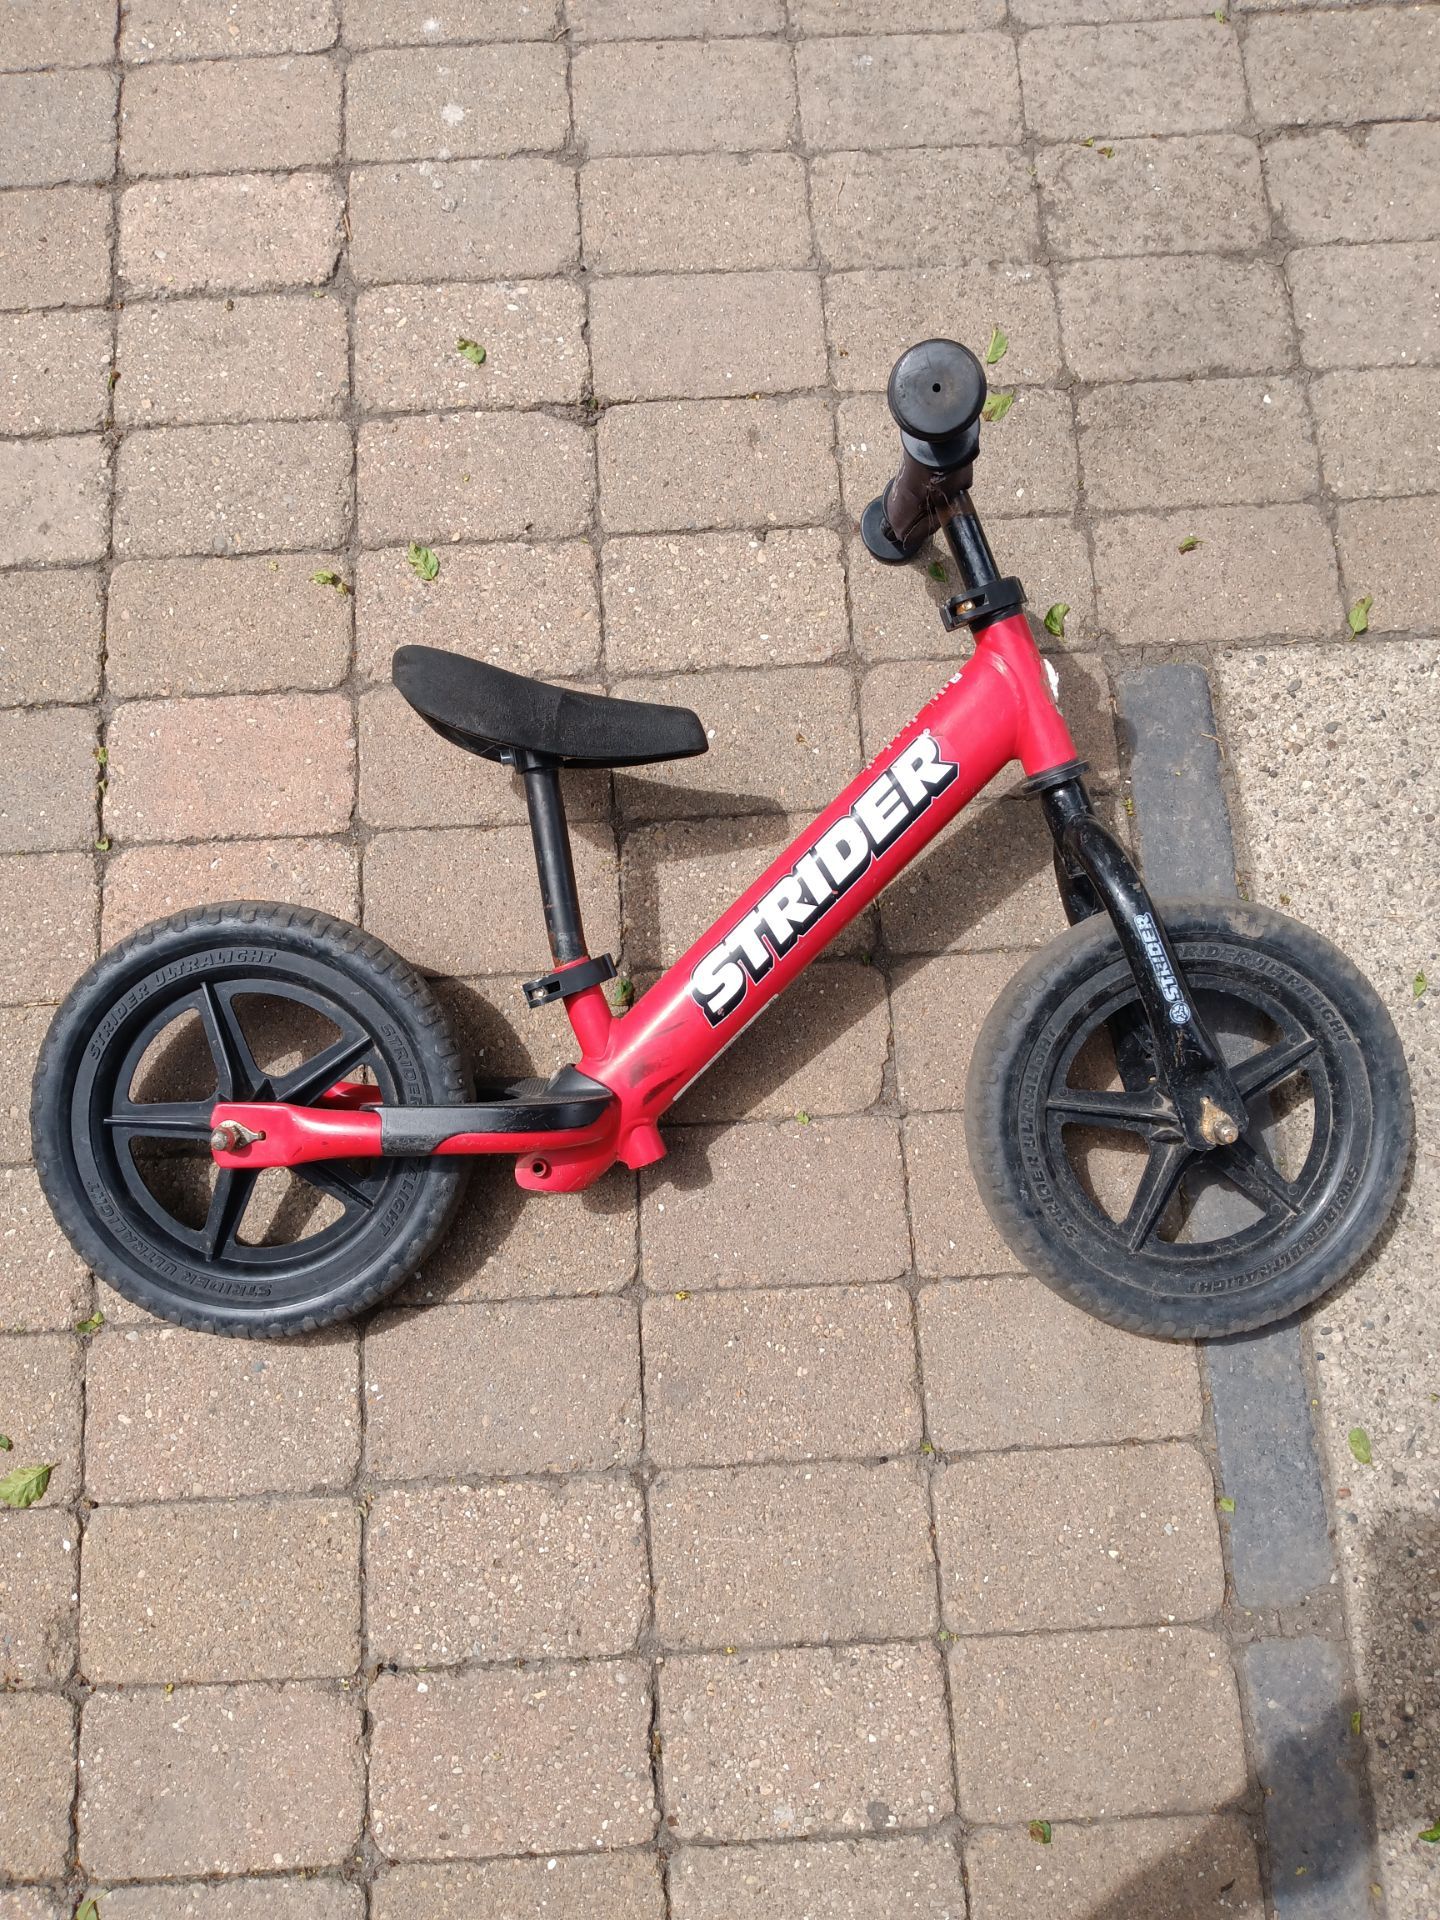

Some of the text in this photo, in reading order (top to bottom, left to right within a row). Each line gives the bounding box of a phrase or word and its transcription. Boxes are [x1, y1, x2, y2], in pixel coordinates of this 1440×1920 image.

[690, 733, 959, 1028] STRIDER
[89, 949, 277, 1060] STRIDER ULTRALIGHT
[1134, 912, 1184, 1003] STRIDER
